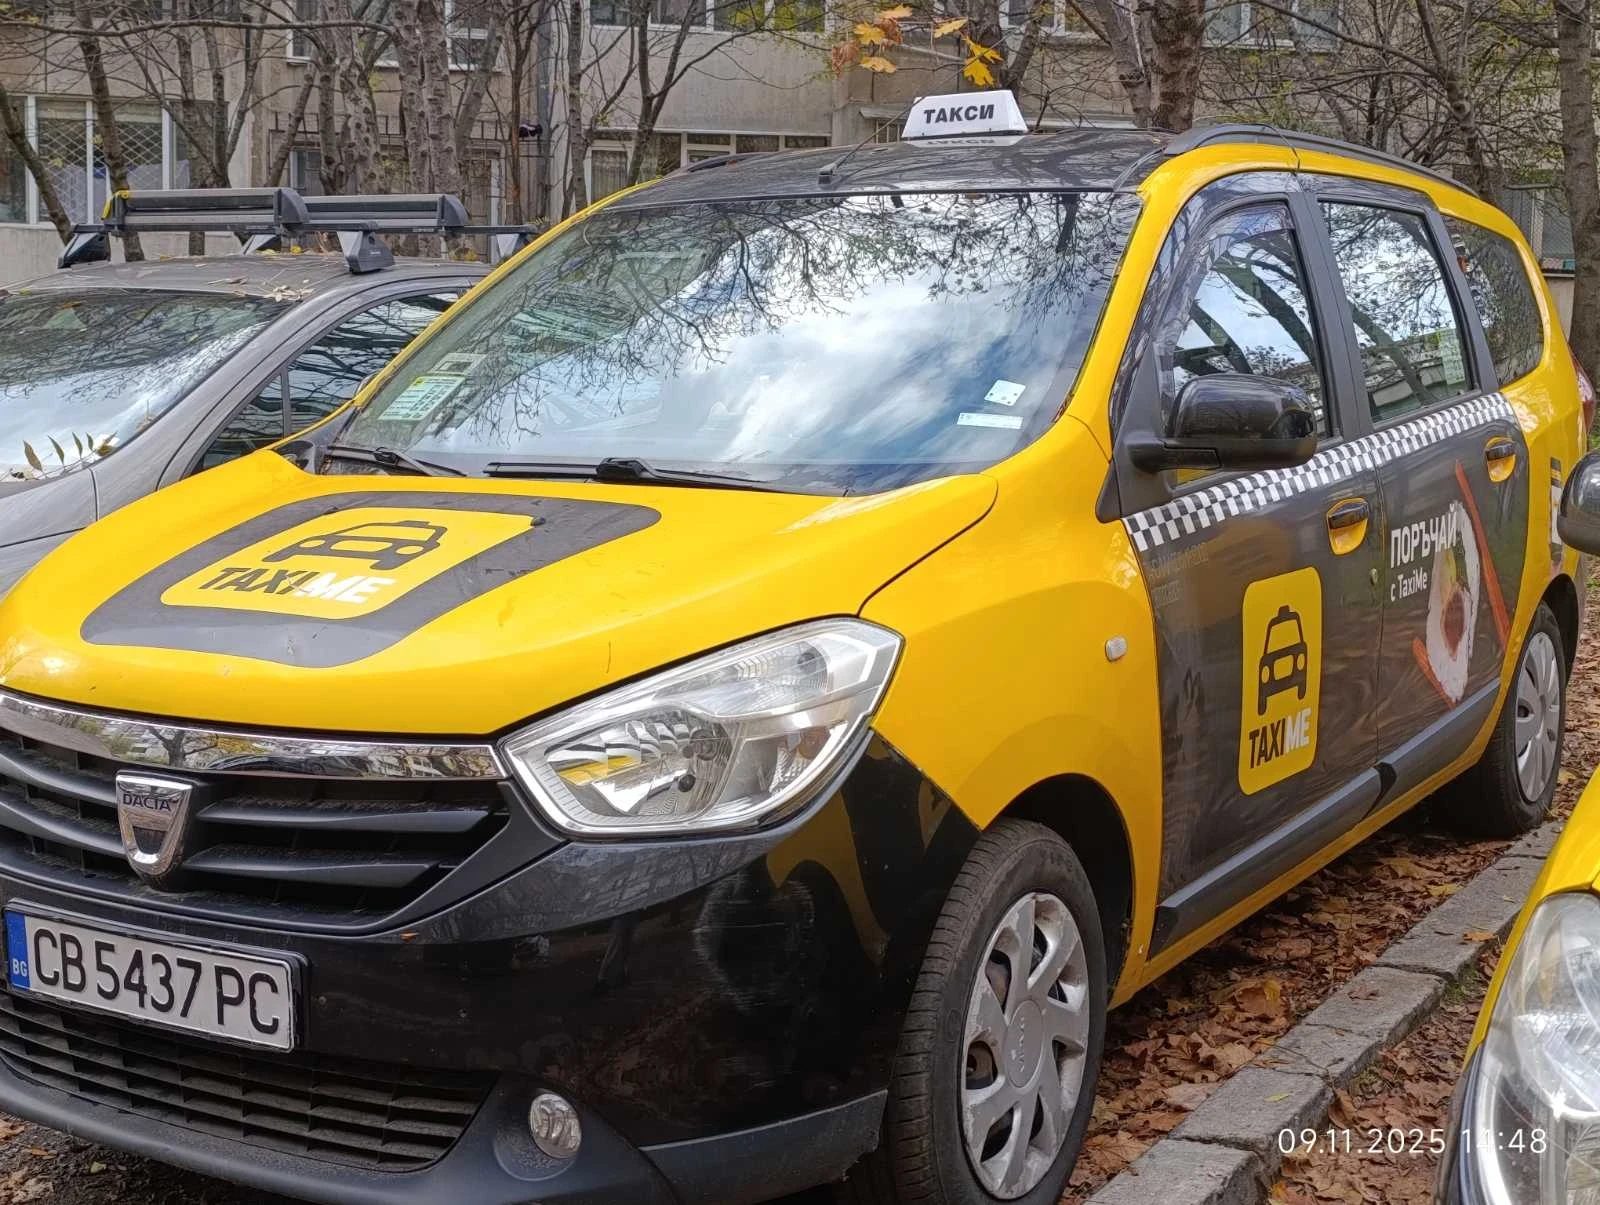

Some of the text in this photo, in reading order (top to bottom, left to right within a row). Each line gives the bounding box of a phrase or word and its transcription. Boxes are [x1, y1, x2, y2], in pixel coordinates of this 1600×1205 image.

[923, 104, 995, 124] ТАКСИ
[1390, 503, 1457, 569] ПОРЪЧАЙ
[1398, 567, 1428, 599] TaxiMe
[1248, 707, 1312, 769] TAXIME
[122, 793, 171, 811] DACIA
[12, 958, 28, 977] BG
[94, 940, 202, 1018] 5437
